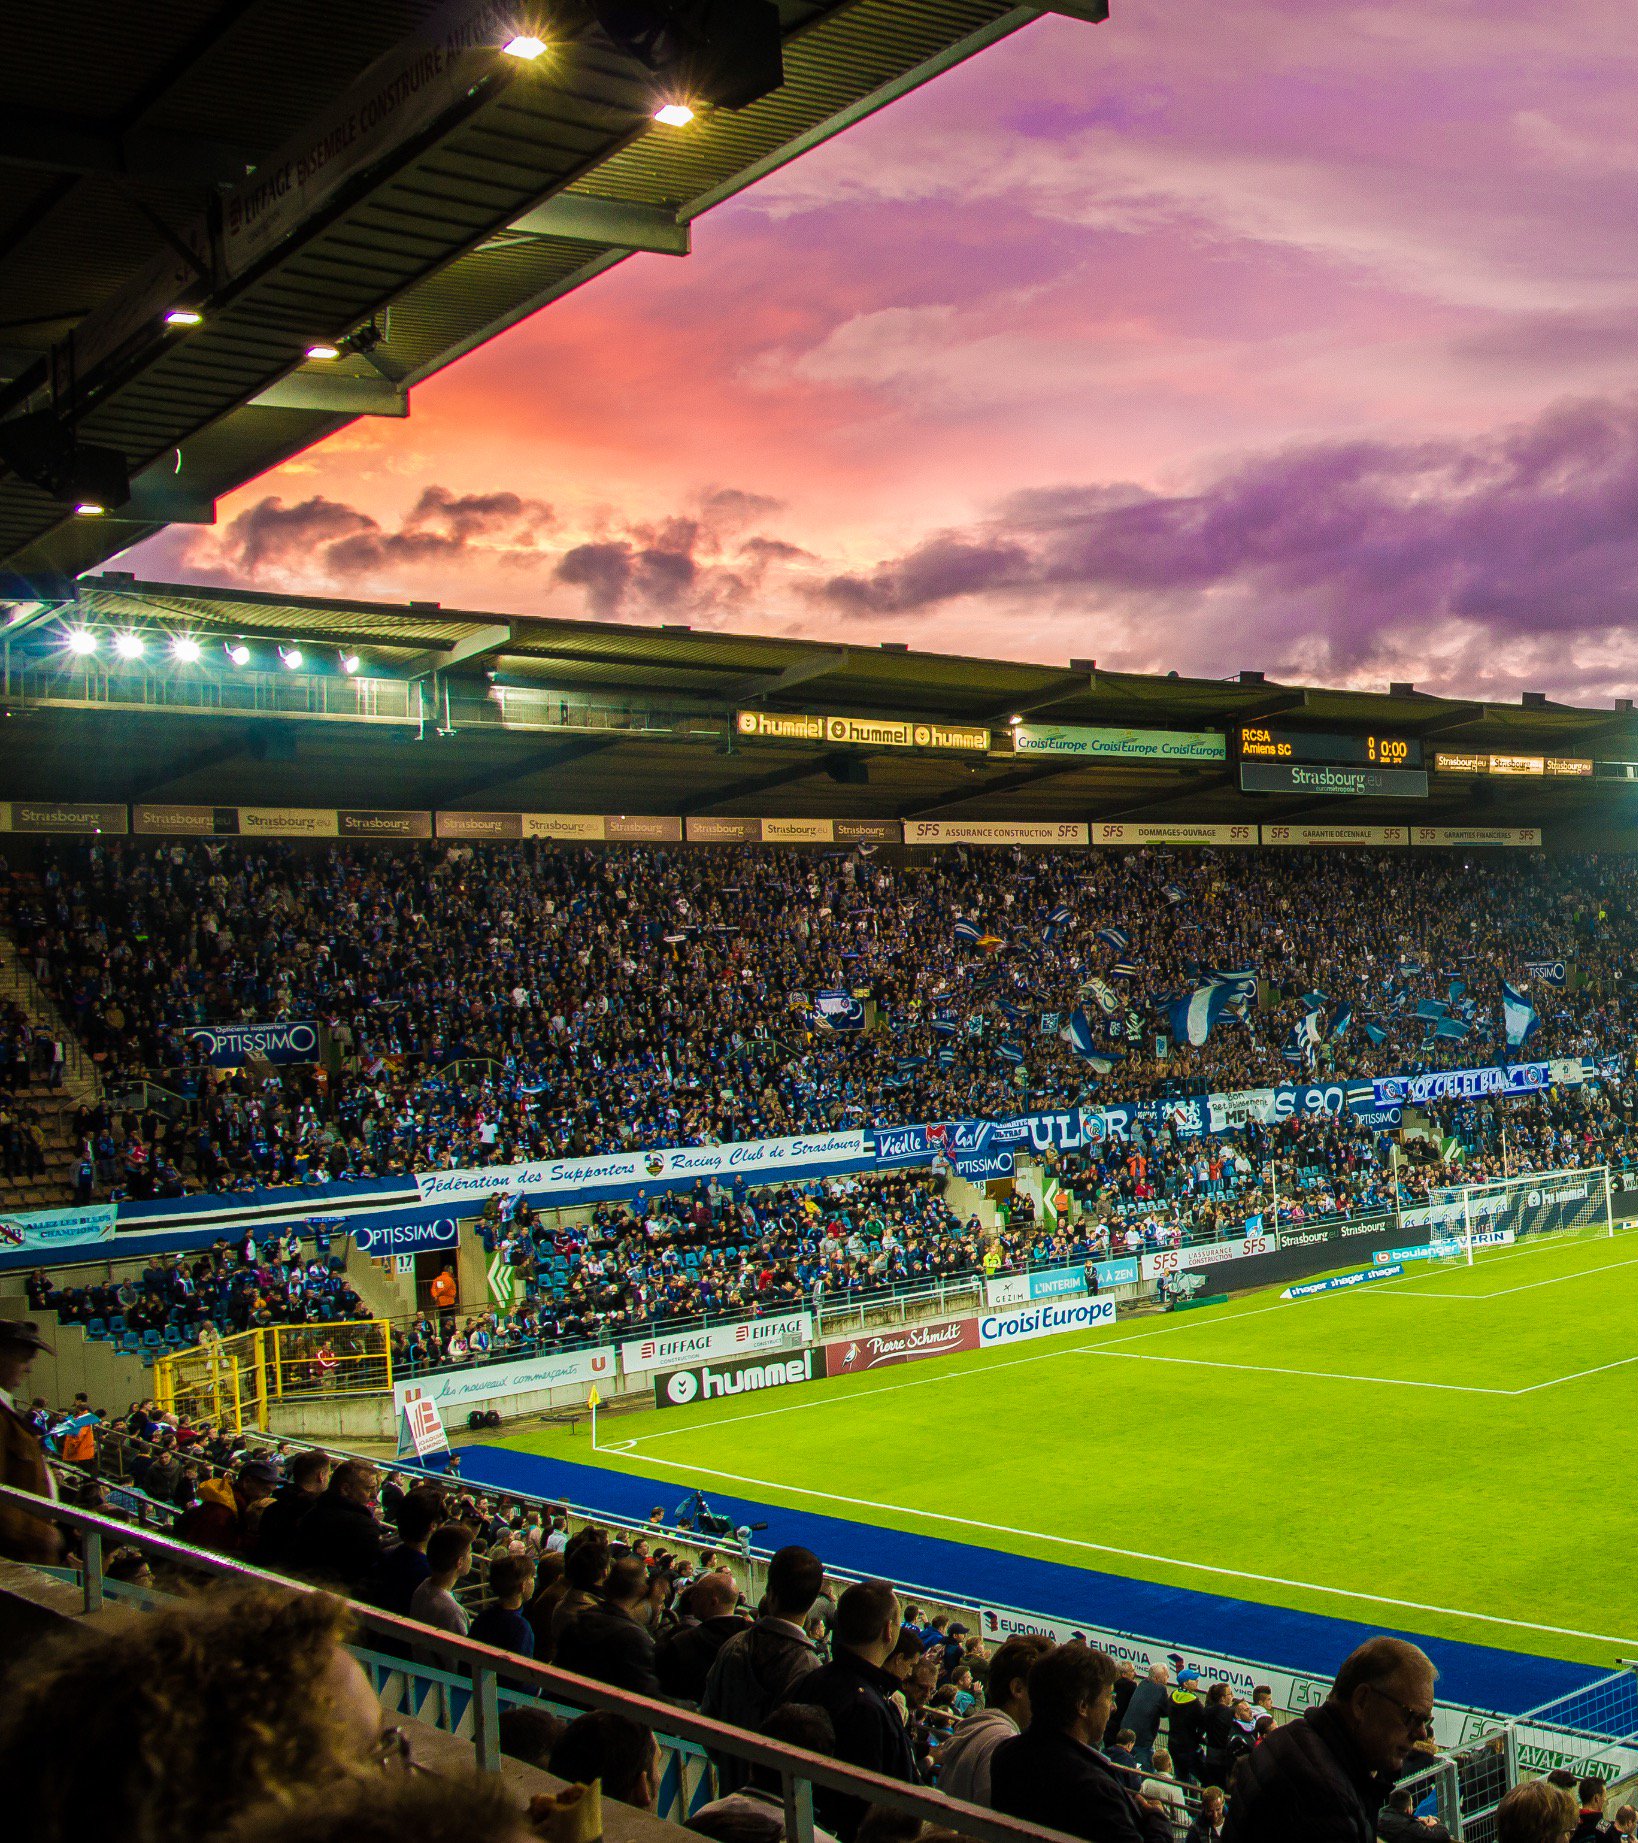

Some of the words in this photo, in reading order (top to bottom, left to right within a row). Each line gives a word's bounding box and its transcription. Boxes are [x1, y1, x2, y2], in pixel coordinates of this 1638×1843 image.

[359, 50, 443, 133] CONSTRUIRE
[759, 718, 822, 738] hummel
[850, 725, 908, 744] hummel
[932, 728, 988, 748] hummel
[1018, 736, 1087, 753] CroisiEurope
[1092, 739, 1158, 756] CroisiEurope
[1243, 729, 1270, 742] RCSA
[1368, 737, 1374, 748] 0
[1161, 742, 1225, 757] CroisiEurope
[1243, 742, 1275, 754] Amiens
[1277, 744, 1292, 755] SC
[1380, 740, 1407, 757] 0:00
[917, 823, 939, 836] SFS
[946, 828, 992, 837] ASSURANCE
[993, 829, 1053, 837] CONSTRUCTION
[1057, 825, 1078, 837] SFS
[1102, 825, 1123, 838] SFS
[1138, 828, 1216, 837] DOMMAGES-OUVRAGE
[1230, 826, 1249, 839] SFS
[1271, 827, 1289, 838] SFS
[1302, 830, 1334, 838] GARANTIE
[1384, 828, 1400, 840] SFS
[1419, 828, 1435, 840] SFS
[1519, 829, 1534, 841] SFS
[1435, 1073, 1461, 1096] CIEL
[1463, 1071, 1478, 1094] ET
[1227, 1092, 1245, 1101] Bon
[1305, 1087, 1344, 1116] 90
[421, 1172, 510, 1196] Fédération
[516, 1170, 543, 1184] des
[550, 1162, 636, 1182] Supporters
[670, 1153, 723, 1171] Racing
[729, 1146, 764, 1164] Club
[769, 1144, 786, 1159] de
[790, 1137, 861, 1160] Strasbourg
[1188, 1246, 1233, 1260] L'ASSURANCE
[1243, 1237, 1266, 1255] SFS
[1393, 1243, 1457, 1259] boulanger
[399, 1256, 413, 1267] 17
[1153, 1252, 1178, 1270] SFS
[1189, 1253, 1233, 1266] CONSTRUCTION
[1035, 1277, 1080, 1294] L'INTERIM
[1114, 1268, 1133, 1280] ZEN
[995, 1293, 1024, 1305] GEZIM
[752, 1318, 802, 1340] EIFFAGE
[982, 1299, 1113, 1340] CroisiEurope
[660, 1335, 713, 1356] EIFFAGE
[753, 1336, 783, 1348] CONSTRUCT
[870, 1336, 905, 1356] Pierre
[907, 1323, 961, 1349] Schmidt
[659, 1353, 700, 1365] CONSTRUCTION
[702, 1348, 811, 1399] hummel
[460, 1375, 508, 1394] nouveaux
[1001, 1620, 1056, 1642] EUROVIA
[1090, 1640, 1151, 1665] EUROVIA
[1188, 1662, 1255, 1687] EUROVIA
[1519, 1745, 1620, 1781] AVALEMENT
